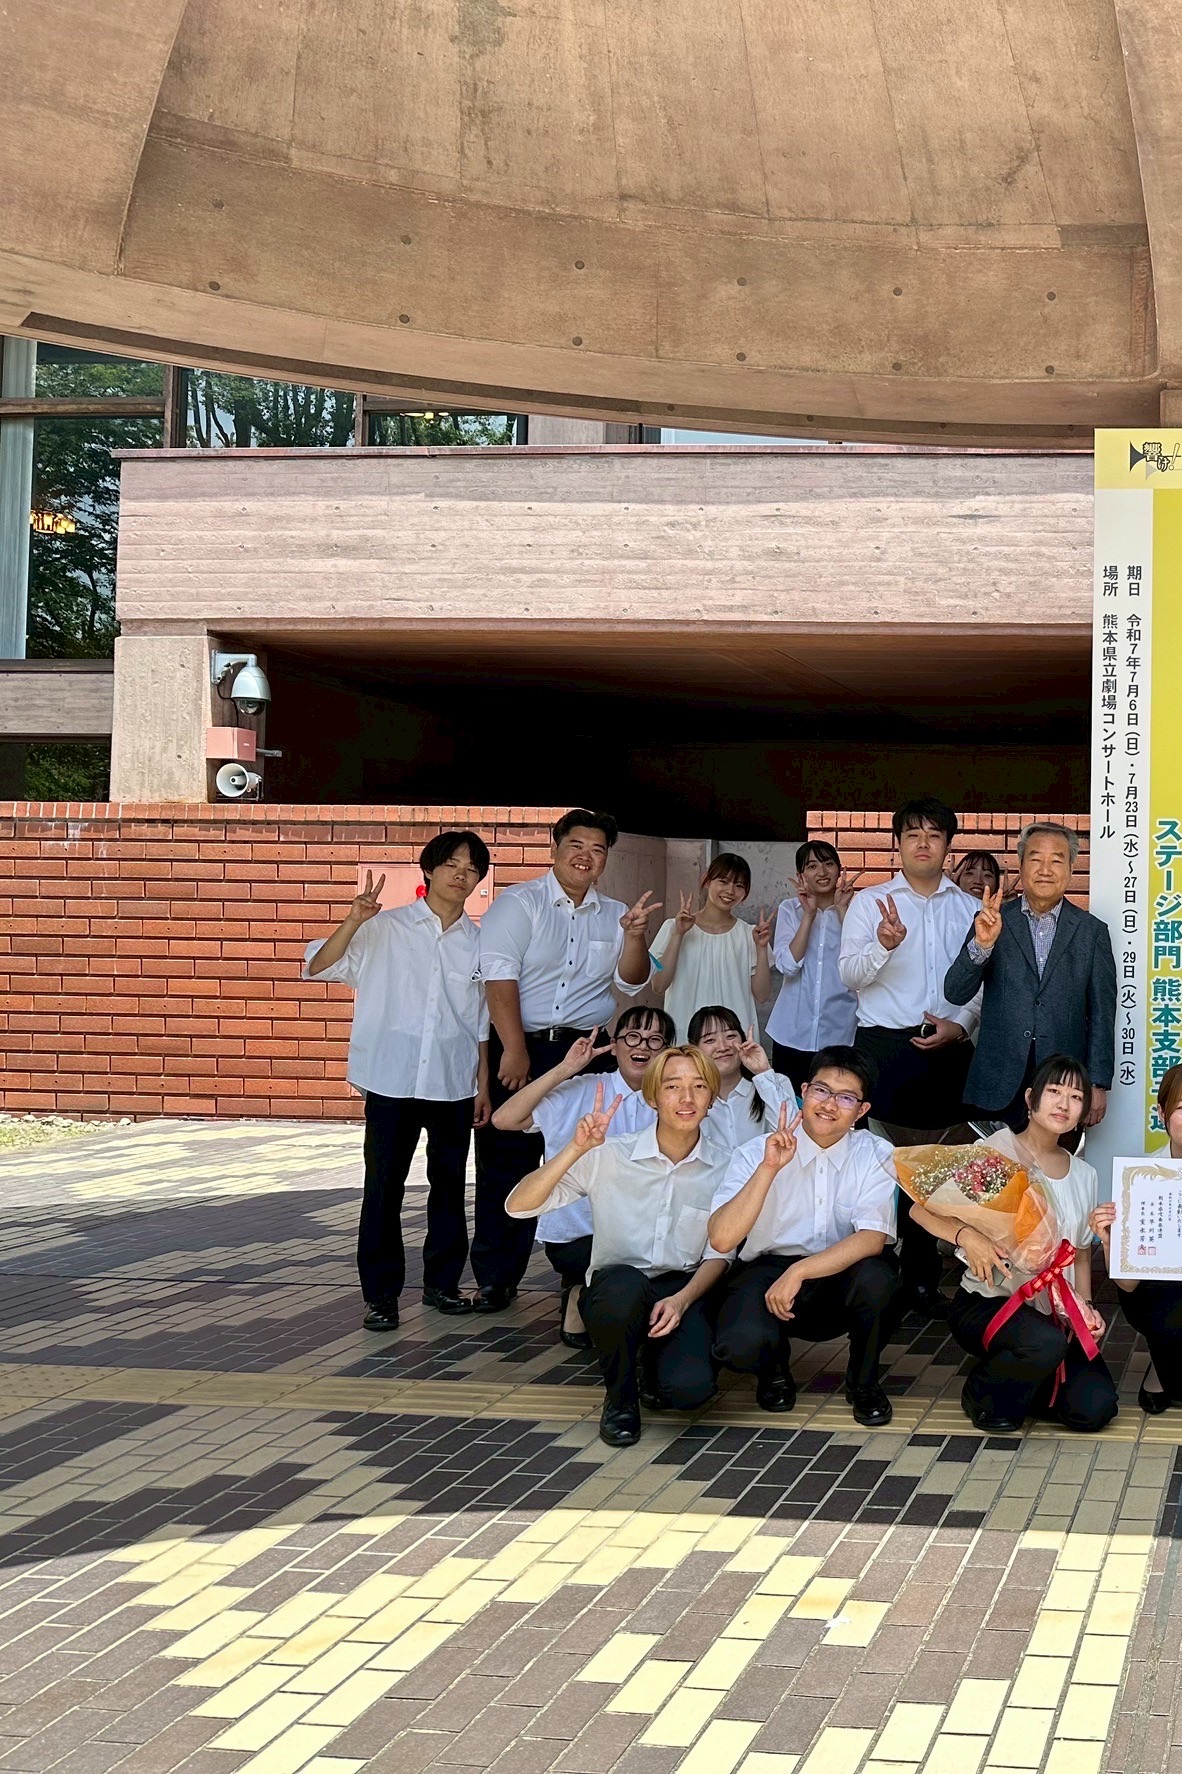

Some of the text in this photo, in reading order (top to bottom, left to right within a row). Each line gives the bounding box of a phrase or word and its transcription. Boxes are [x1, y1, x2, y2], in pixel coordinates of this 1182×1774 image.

[1127, 565, 1142, 596] 期日
[1099, 565, 1118, 839] 場所 熊本県立劇場コンサートホール
